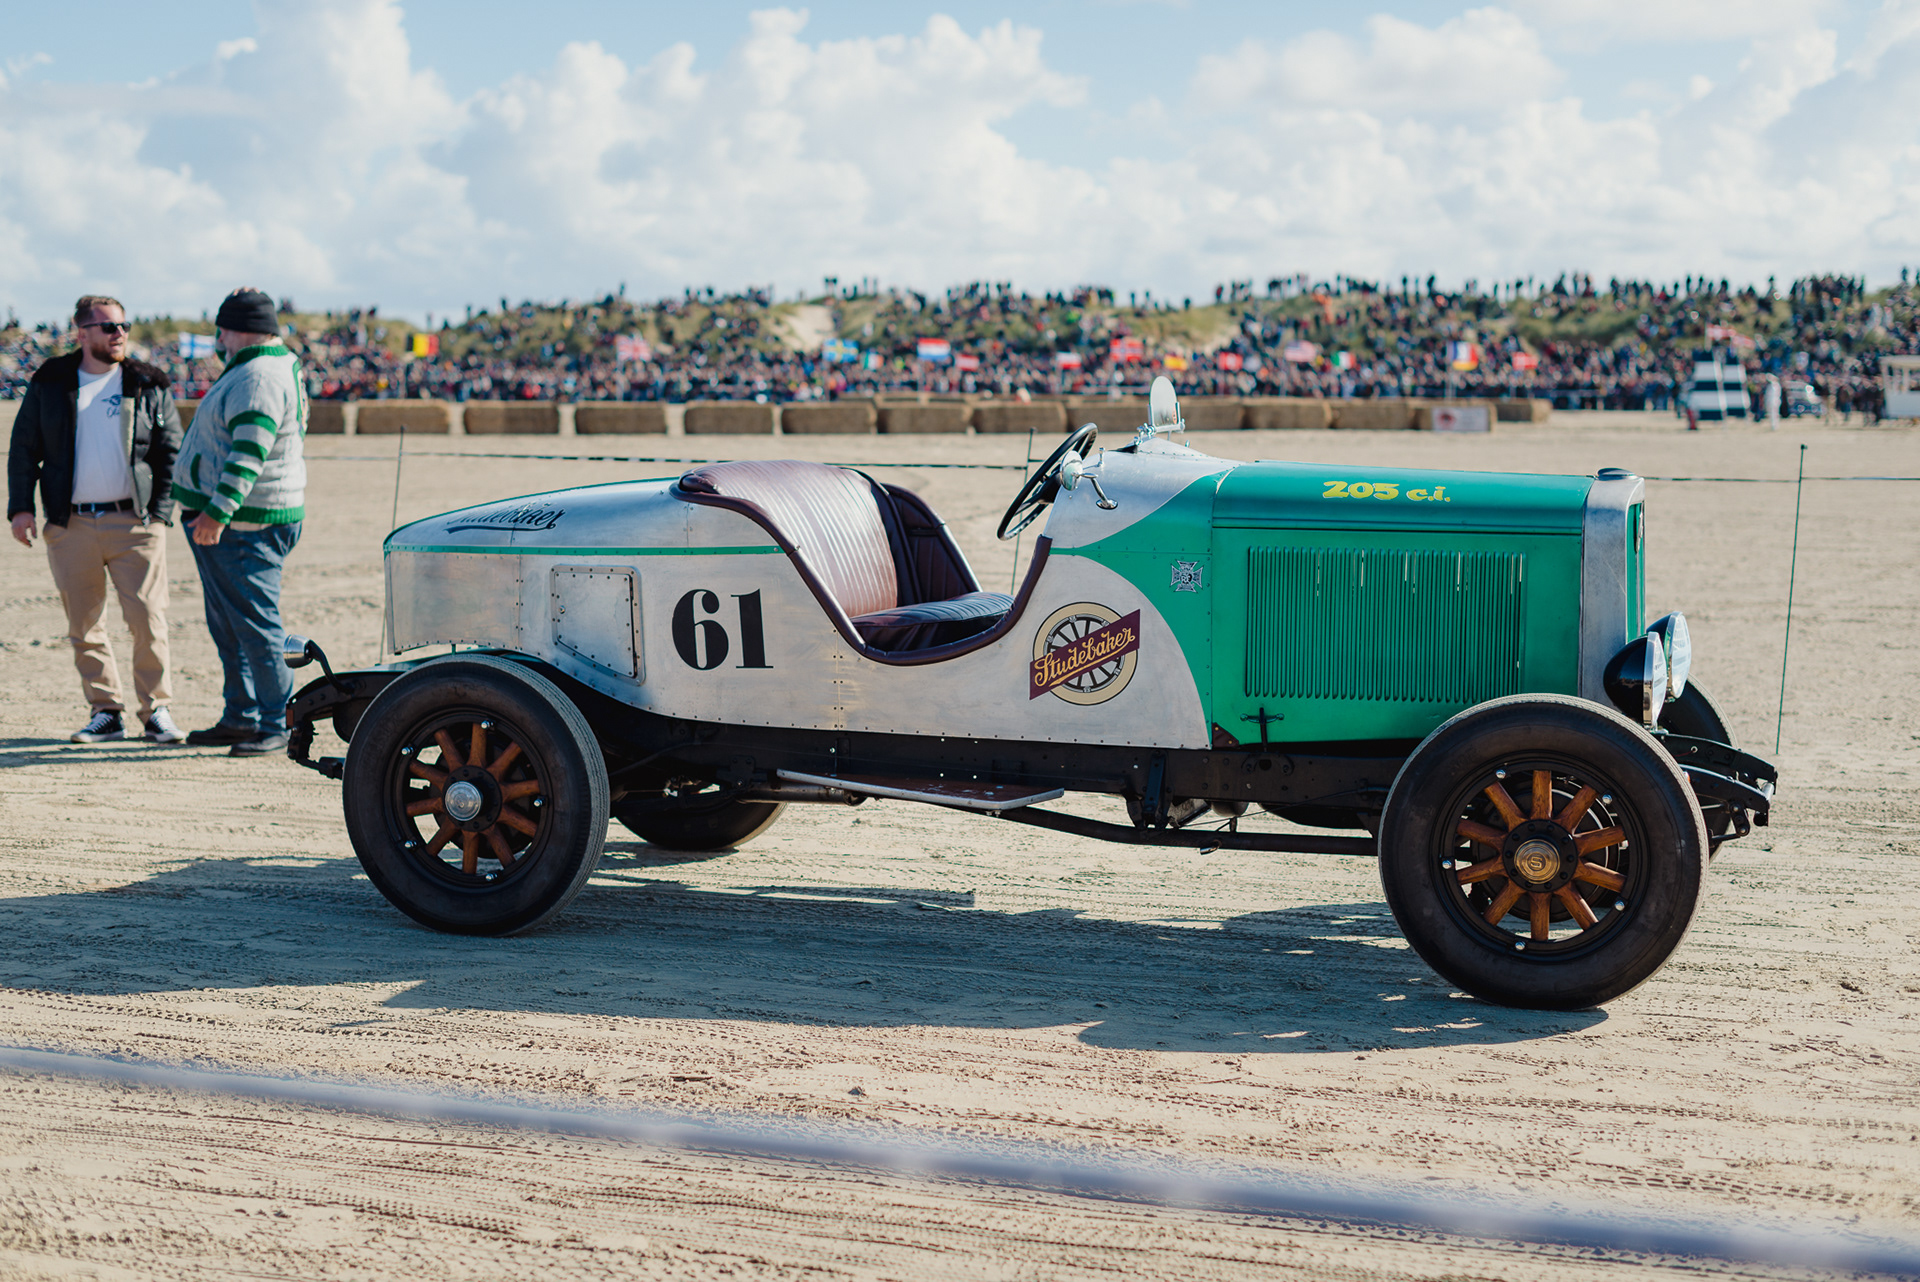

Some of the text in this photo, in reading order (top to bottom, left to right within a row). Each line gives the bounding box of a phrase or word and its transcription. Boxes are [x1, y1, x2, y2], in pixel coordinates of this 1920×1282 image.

[1322, 480, 1451, 502] 205 c.i.
[444, 501, 566, 534] tudebaker
[671, 588, 774, 671] 61
[1034, 627, 1136, 687] Studebaker
[1530, 856, 1543, 869] S
